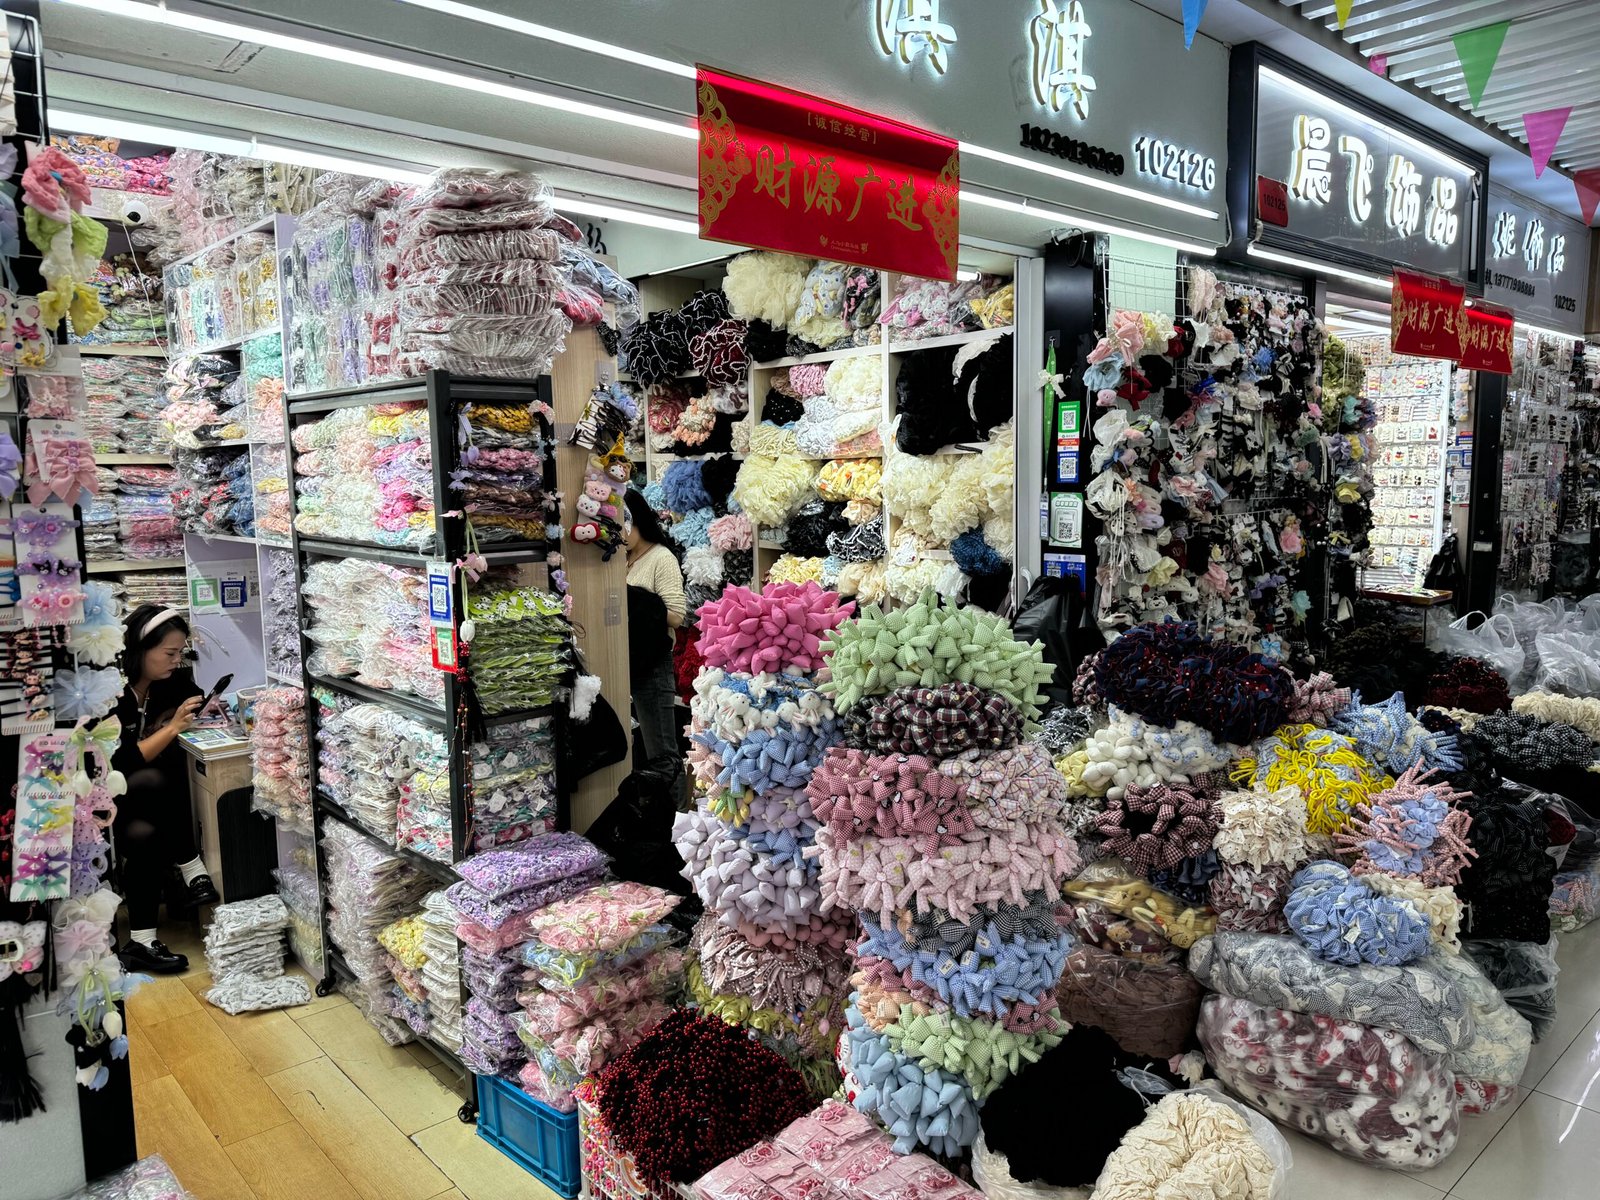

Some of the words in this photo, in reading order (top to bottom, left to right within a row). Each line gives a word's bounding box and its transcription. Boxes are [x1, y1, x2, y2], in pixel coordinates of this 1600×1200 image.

[752, 142, 923, 231] 财源广进
[1134, 136, 1216, 190] 102126
[1288, 114, 1458, 246] 晨飞饰品
[1406, 298, 1455, 334] 财源广进
[1470, 321, 1505, 352] 财源广进
